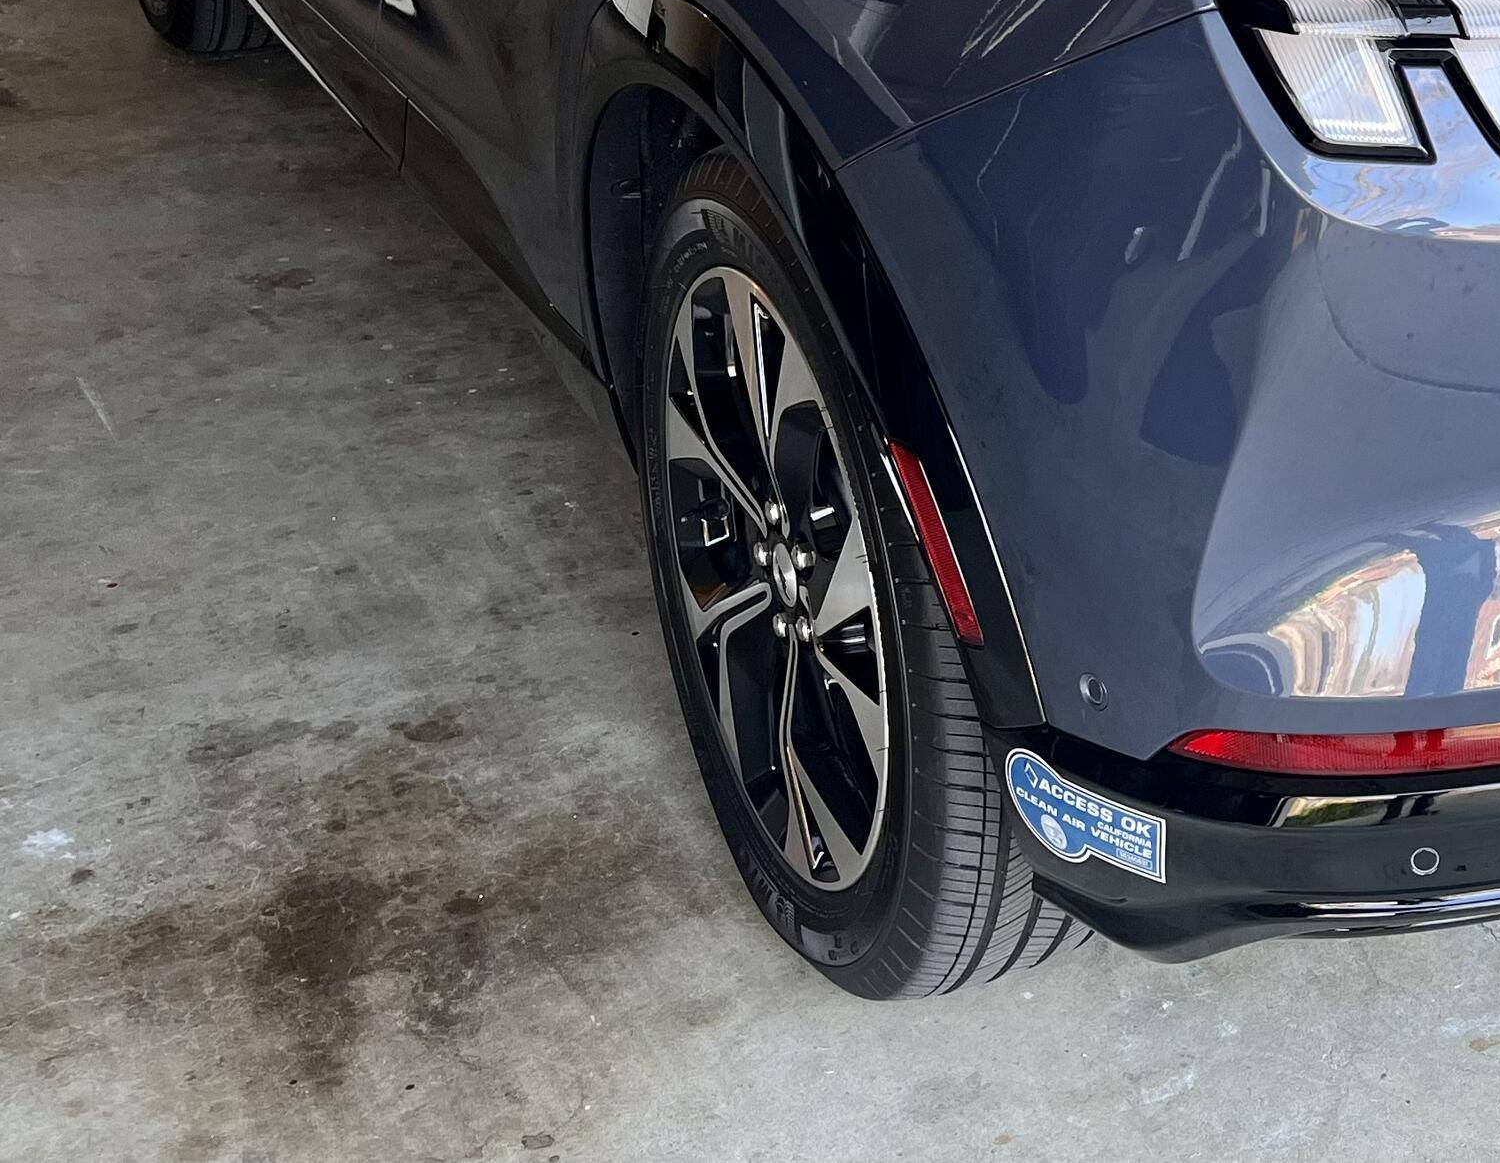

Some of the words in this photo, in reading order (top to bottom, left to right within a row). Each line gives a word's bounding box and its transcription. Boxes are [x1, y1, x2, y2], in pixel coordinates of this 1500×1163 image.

[1015, 786, 1058, 817] CLEAN
[1061, 813, 1086, 832] AIR
[1090, 826, 1152, 859] VEHICLE
[1038, 777, 1113, 824] ACCESS
[1121, 816, 1152, 838] OK
[1096, 821, 1152, 849] CALIFORNIA
